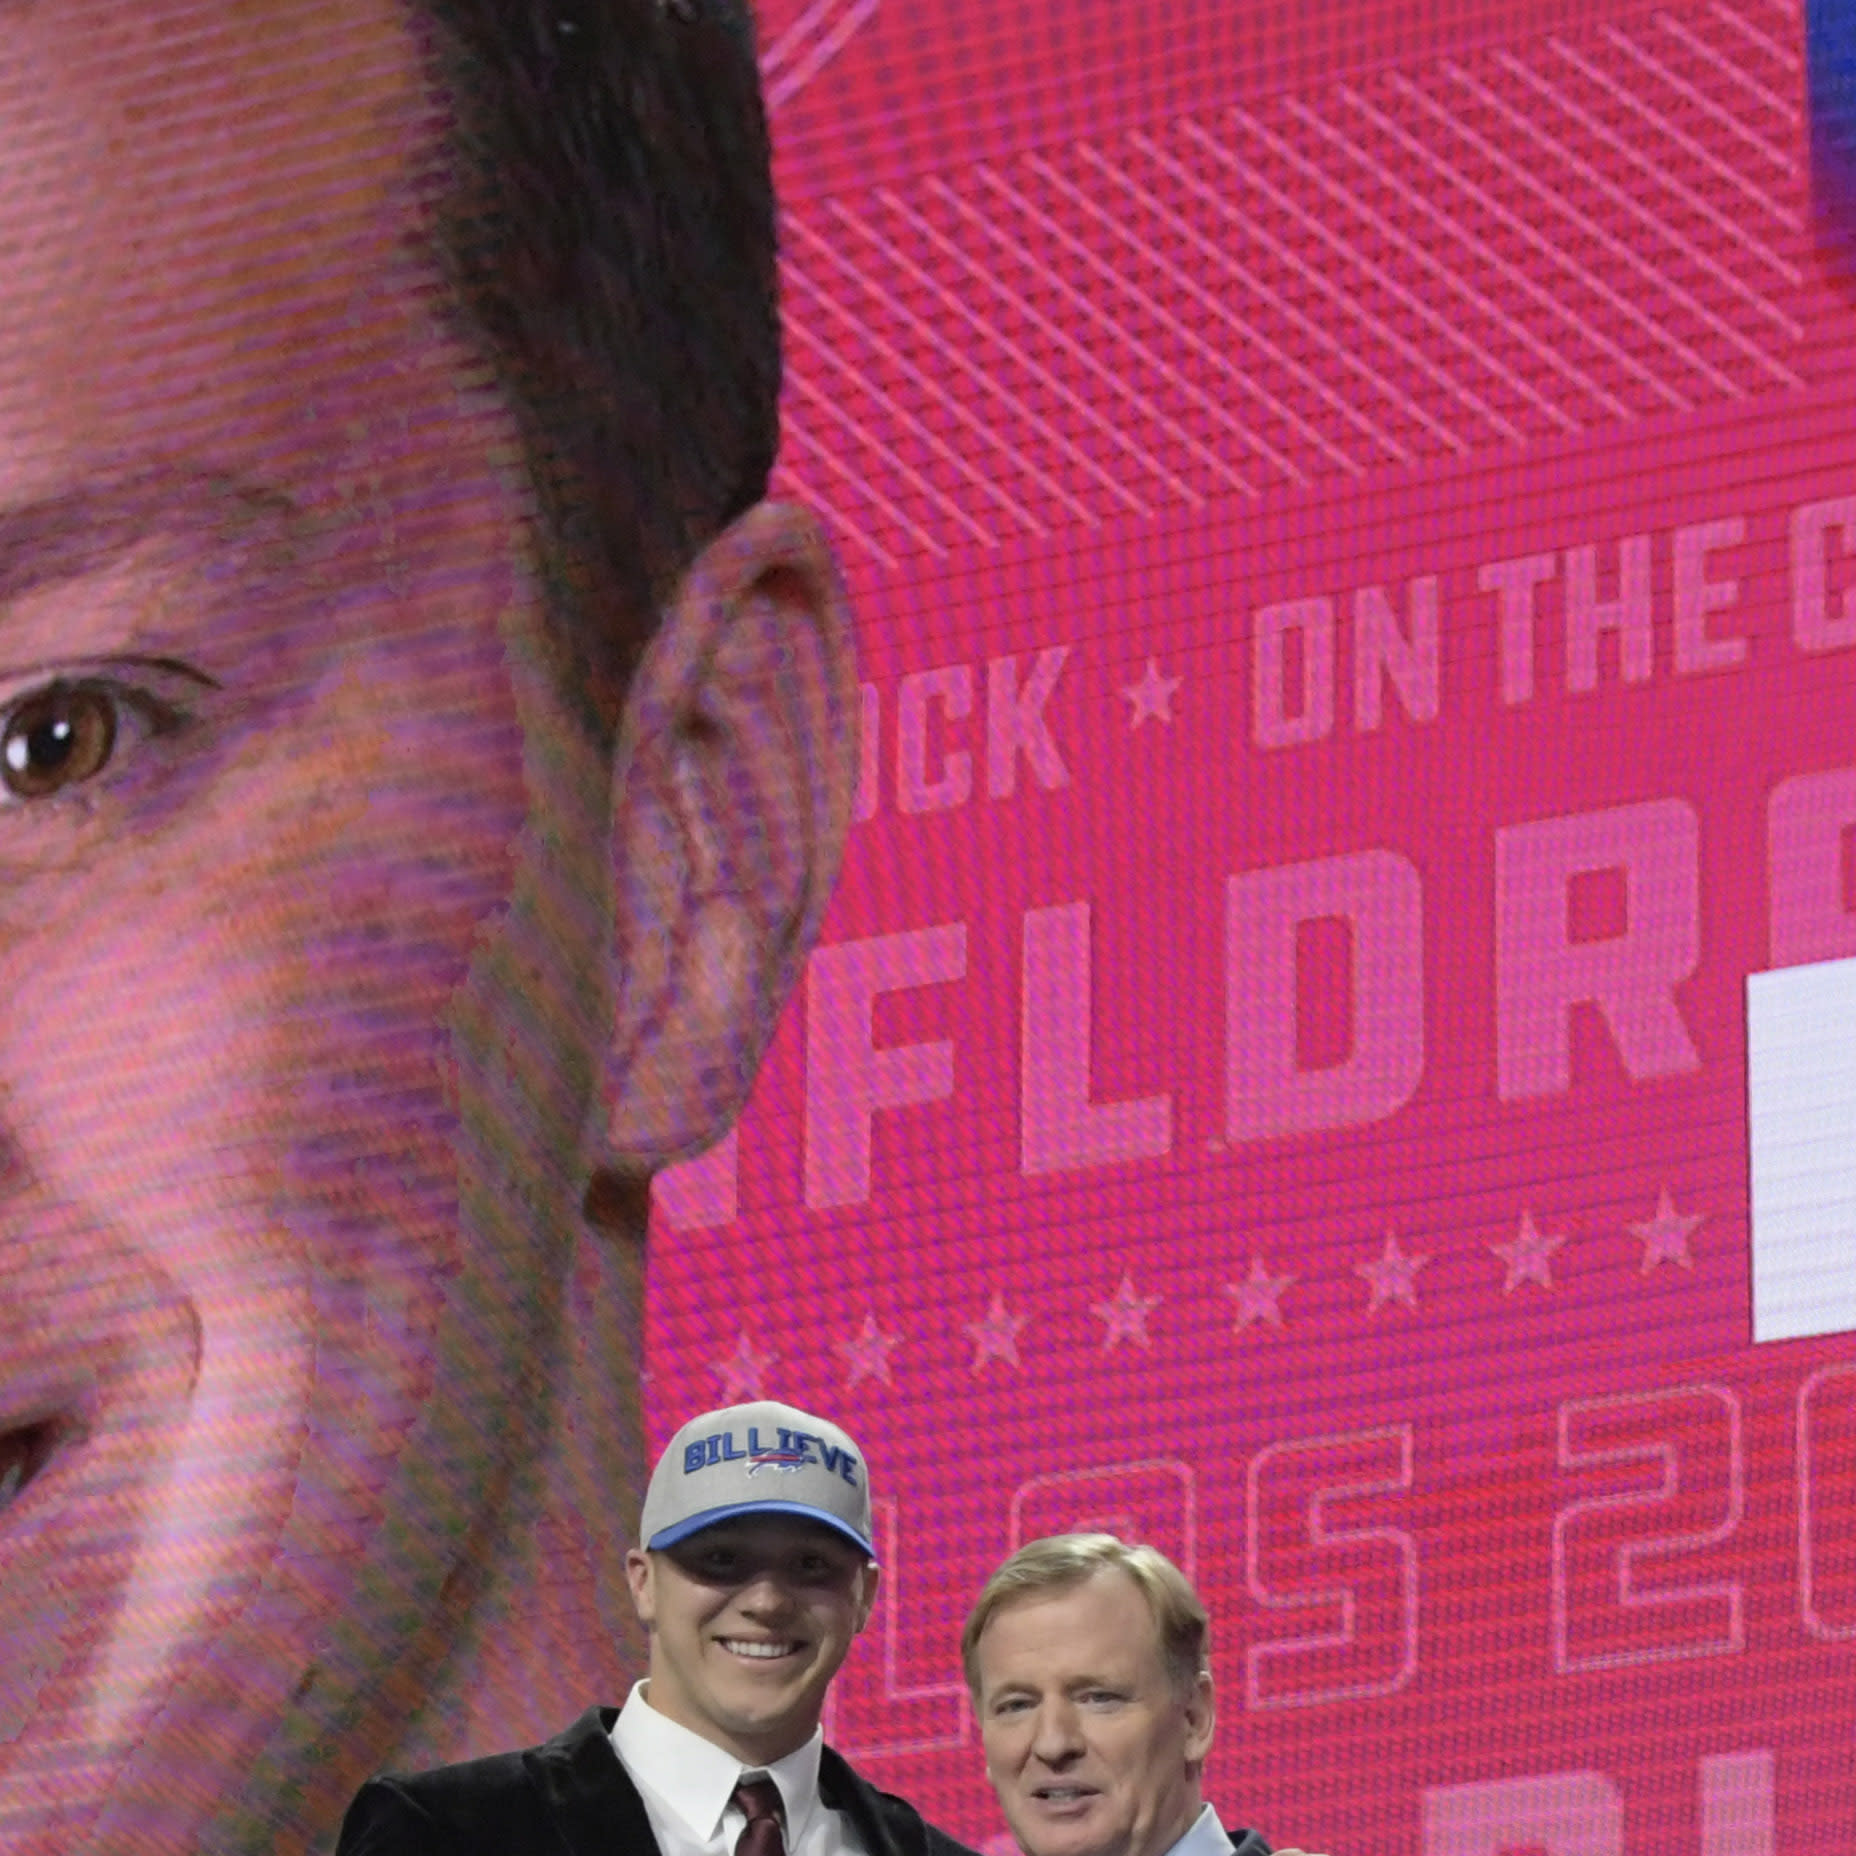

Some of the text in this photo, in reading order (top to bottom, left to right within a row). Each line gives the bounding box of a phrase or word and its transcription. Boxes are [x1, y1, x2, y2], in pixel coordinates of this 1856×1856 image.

[1250, 575, 1439, 753] ON
[1478, 518, 1747, 706] THE
[683, 1425, 859, 1488] BILLIEVE
